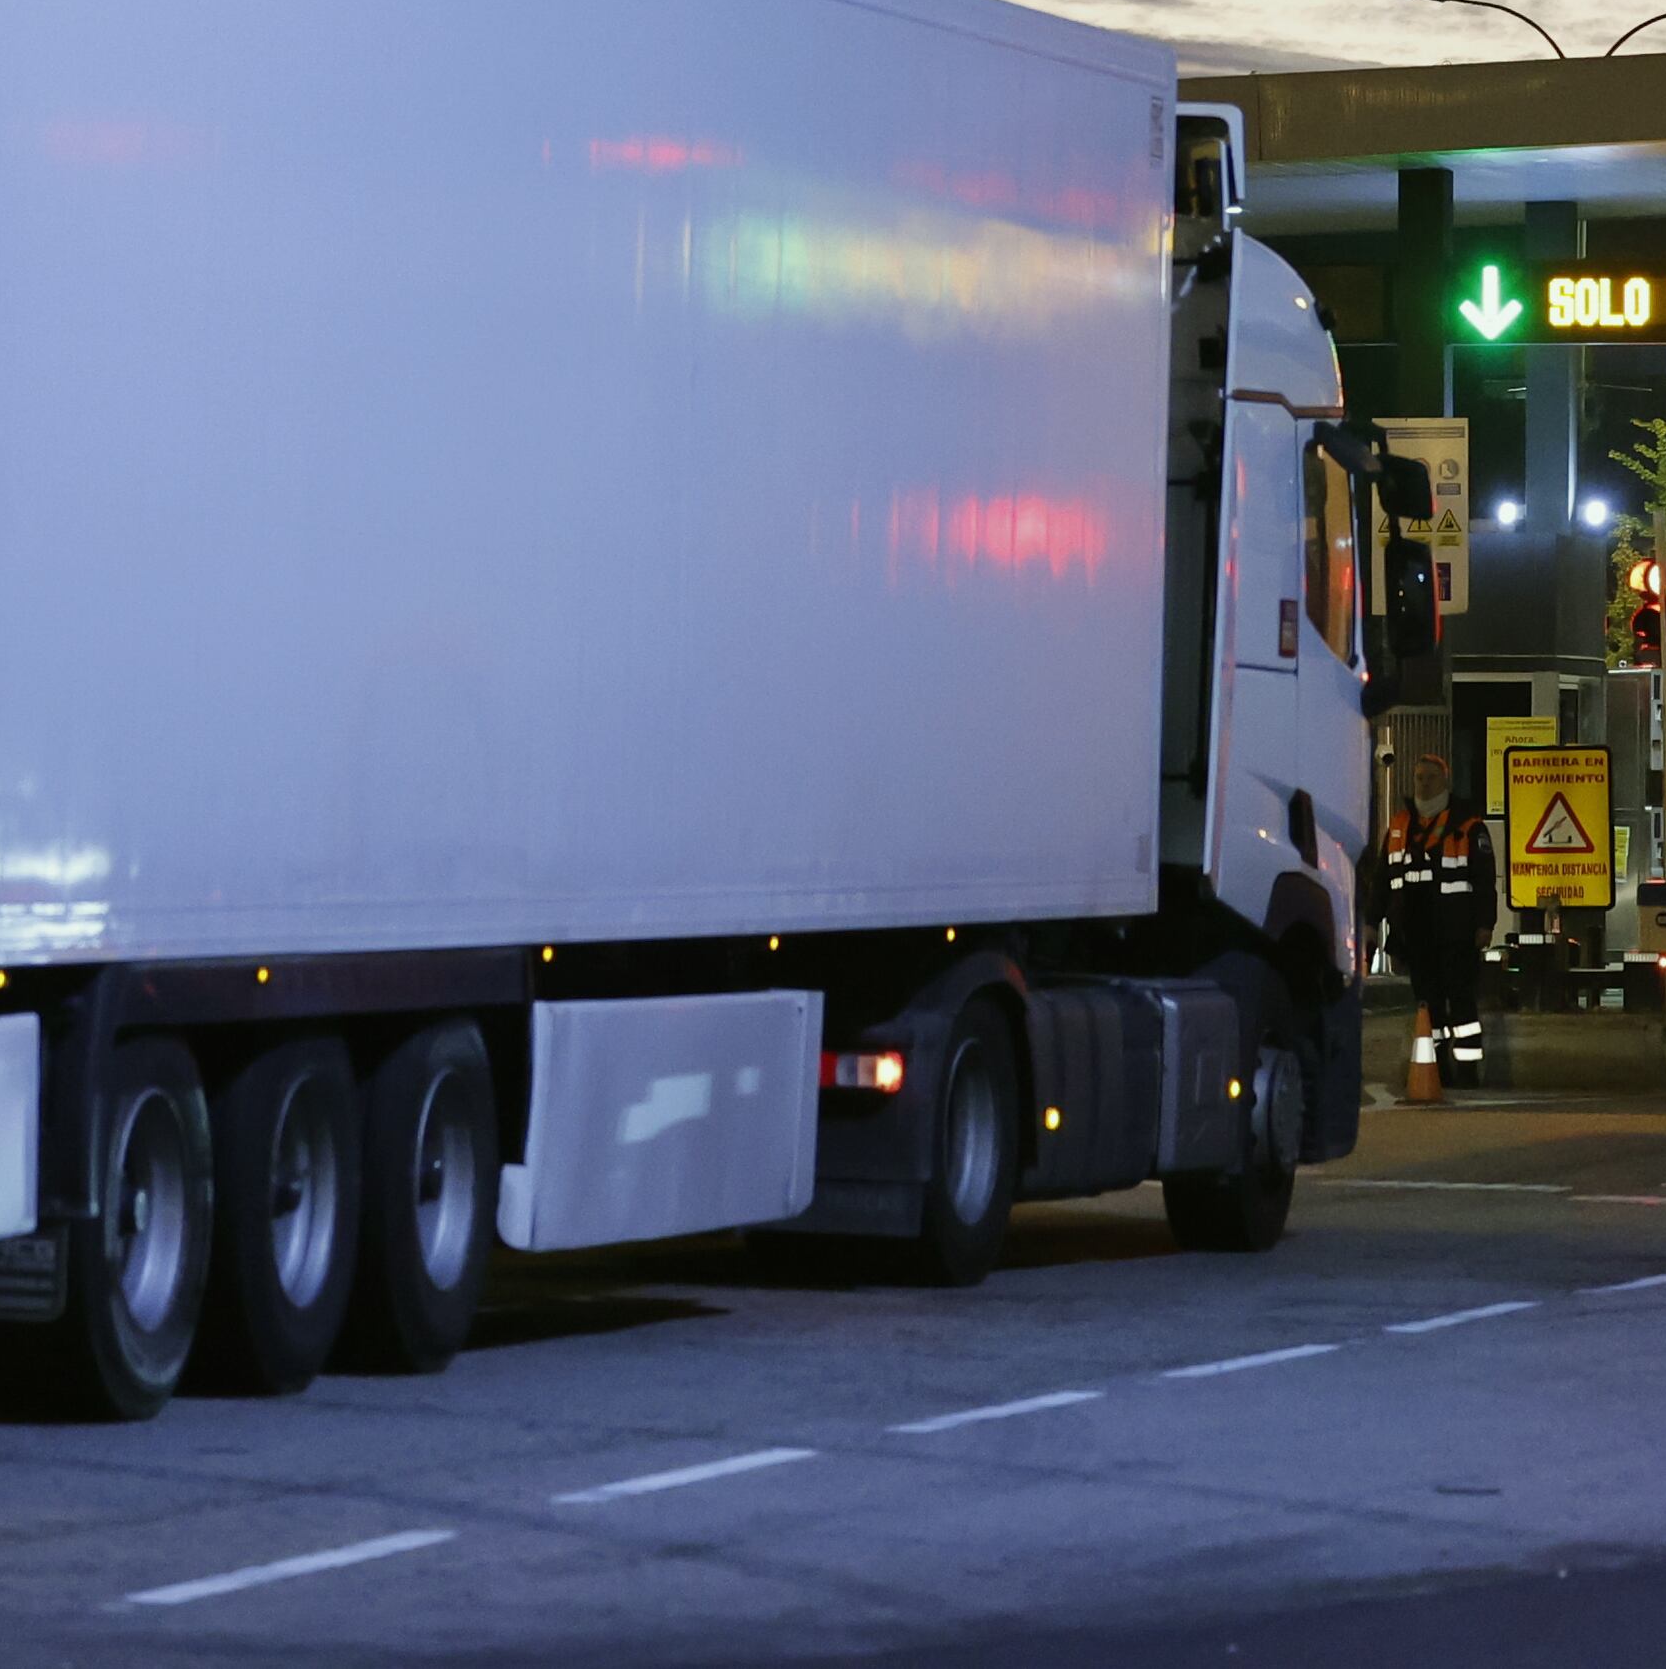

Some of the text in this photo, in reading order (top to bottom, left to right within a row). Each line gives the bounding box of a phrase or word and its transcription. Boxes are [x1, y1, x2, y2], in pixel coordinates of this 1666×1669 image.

[1547, 277, 1651, 327] SOLO
[1512, 757, 1604, 768] BARRERA EN
[1512, 774, 1605, 784] MOVIMIENTO
[1562, 861, 1608, 876] DISTANCIA
